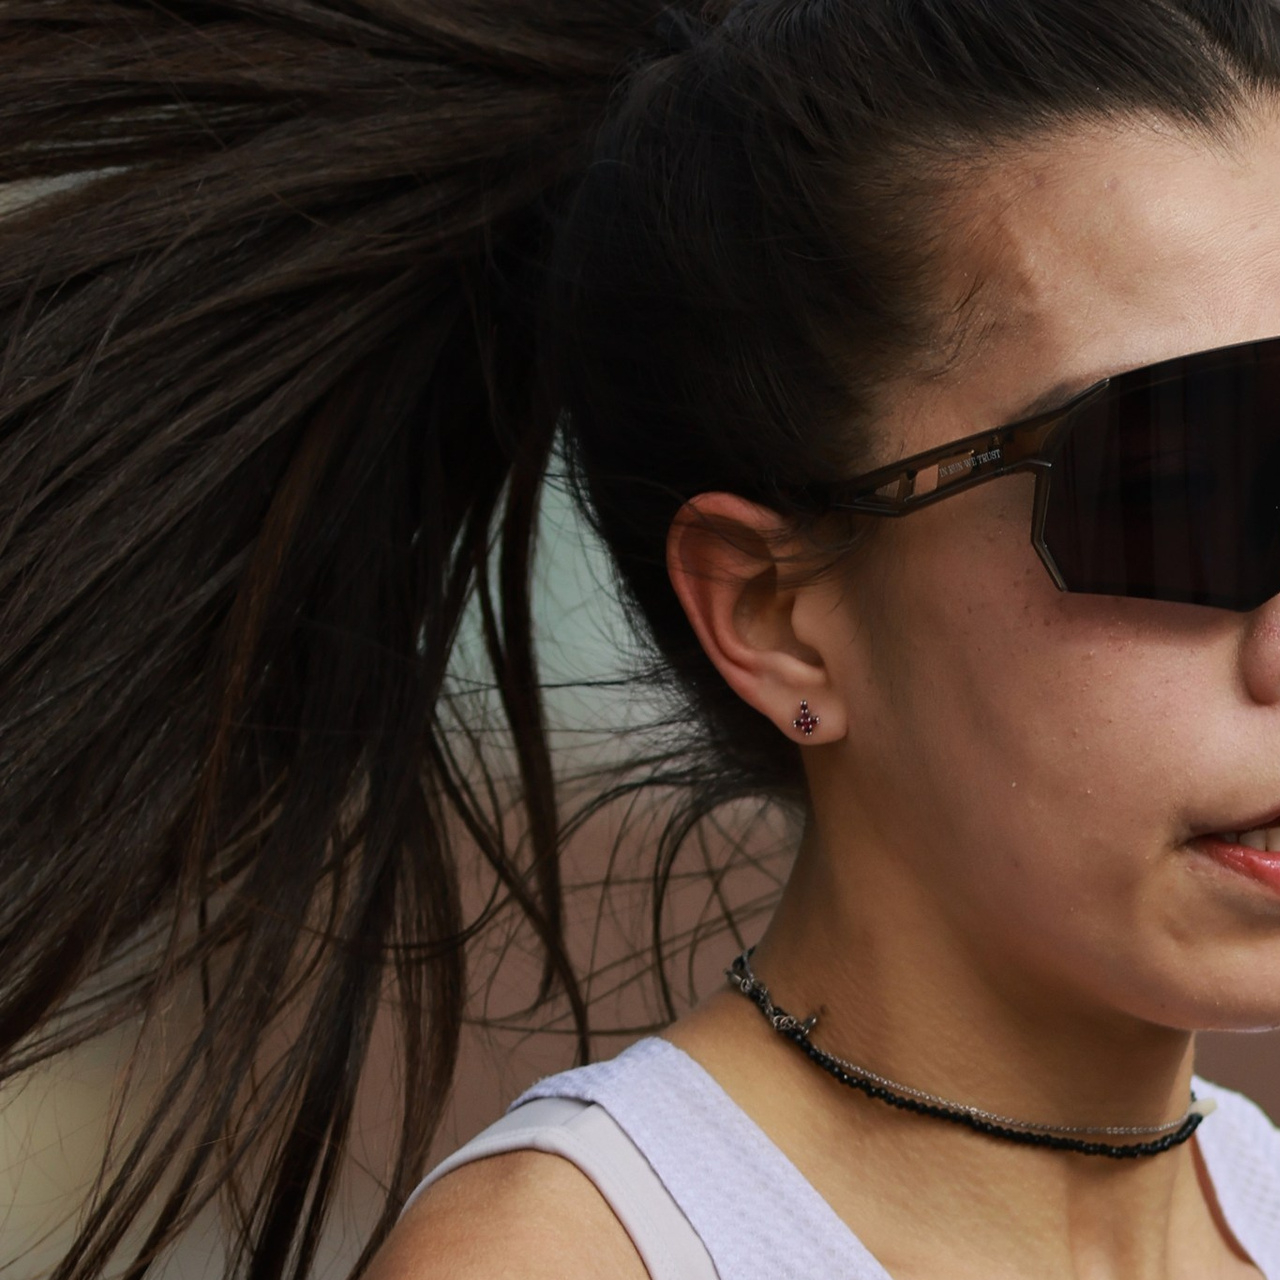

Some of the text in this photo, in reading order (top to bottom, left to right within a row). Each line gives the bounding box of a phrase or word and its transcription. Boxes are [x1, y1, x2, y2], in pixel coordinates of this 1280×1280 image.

[939, 448, 1001, 478] IN RUN WE TRUST
